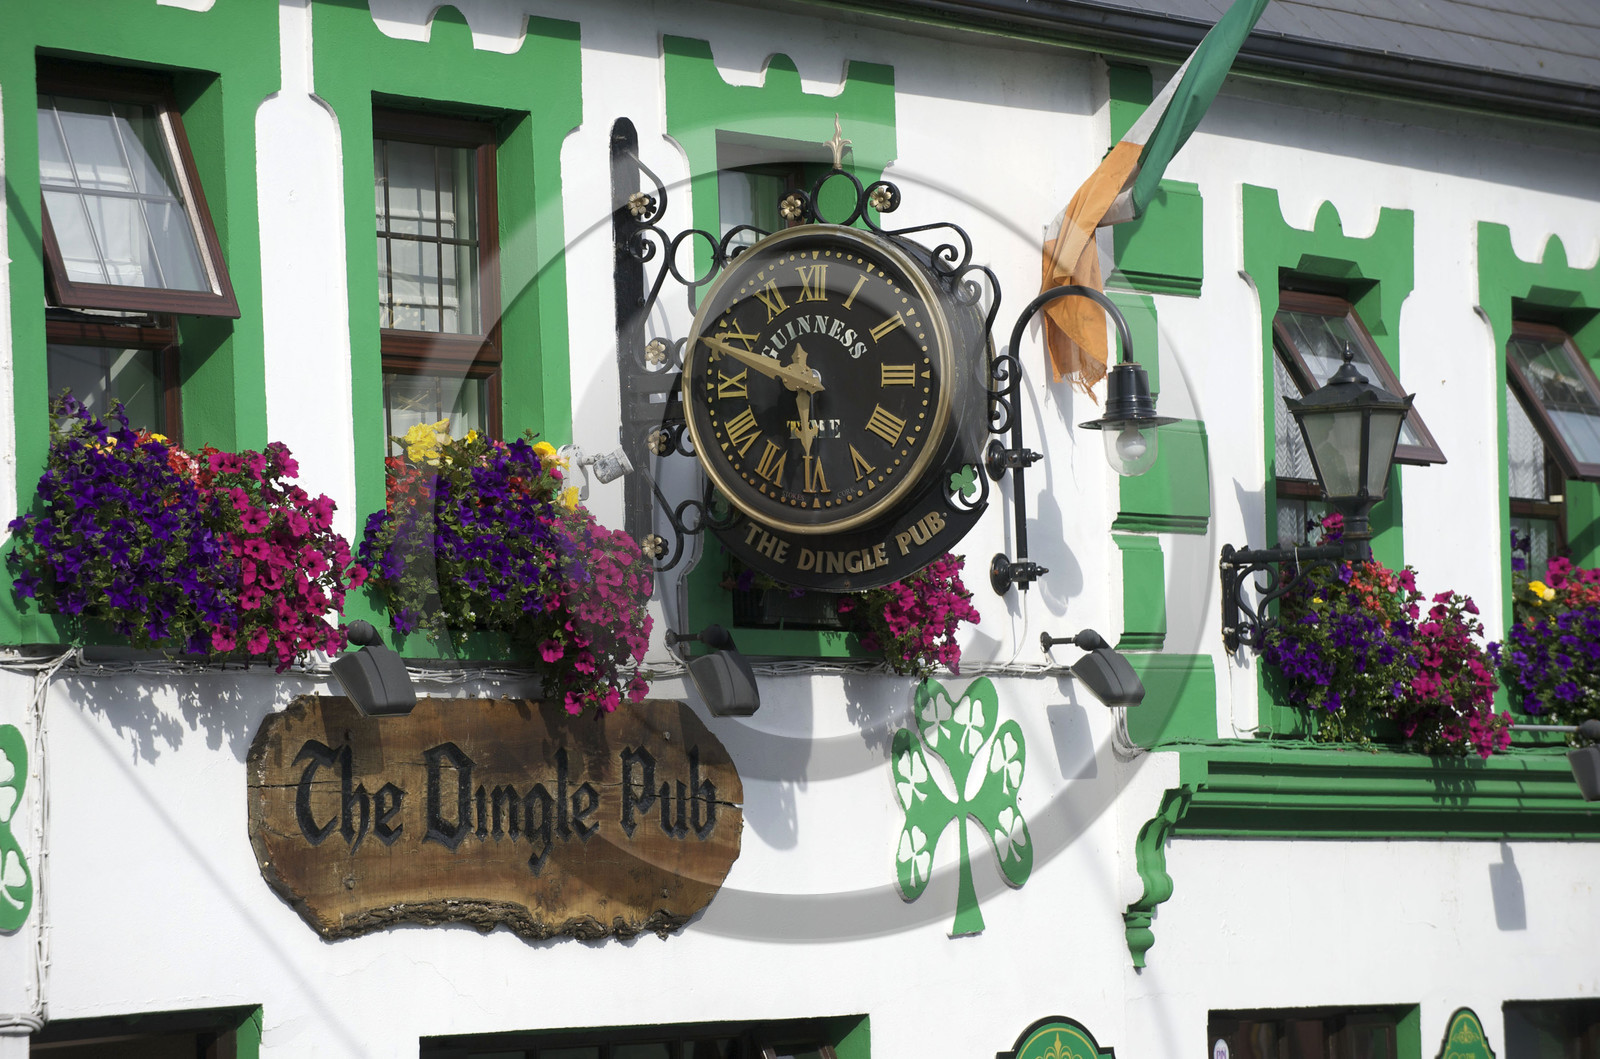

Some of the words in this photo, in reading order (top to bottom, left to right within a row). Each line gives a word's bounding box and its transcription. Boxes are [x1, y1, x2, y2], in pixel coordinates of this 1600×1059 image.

[786, 419, 841, 439] TME
[744, 522, 790, 564] THE
[797, 542, 889, 574] DINGLE
[895, 511, 946, 557] PUB
[292, 739, 406, 856] The
[421, 741, 600, 877] Dingle
[620, 744, 718, 842] Pub
